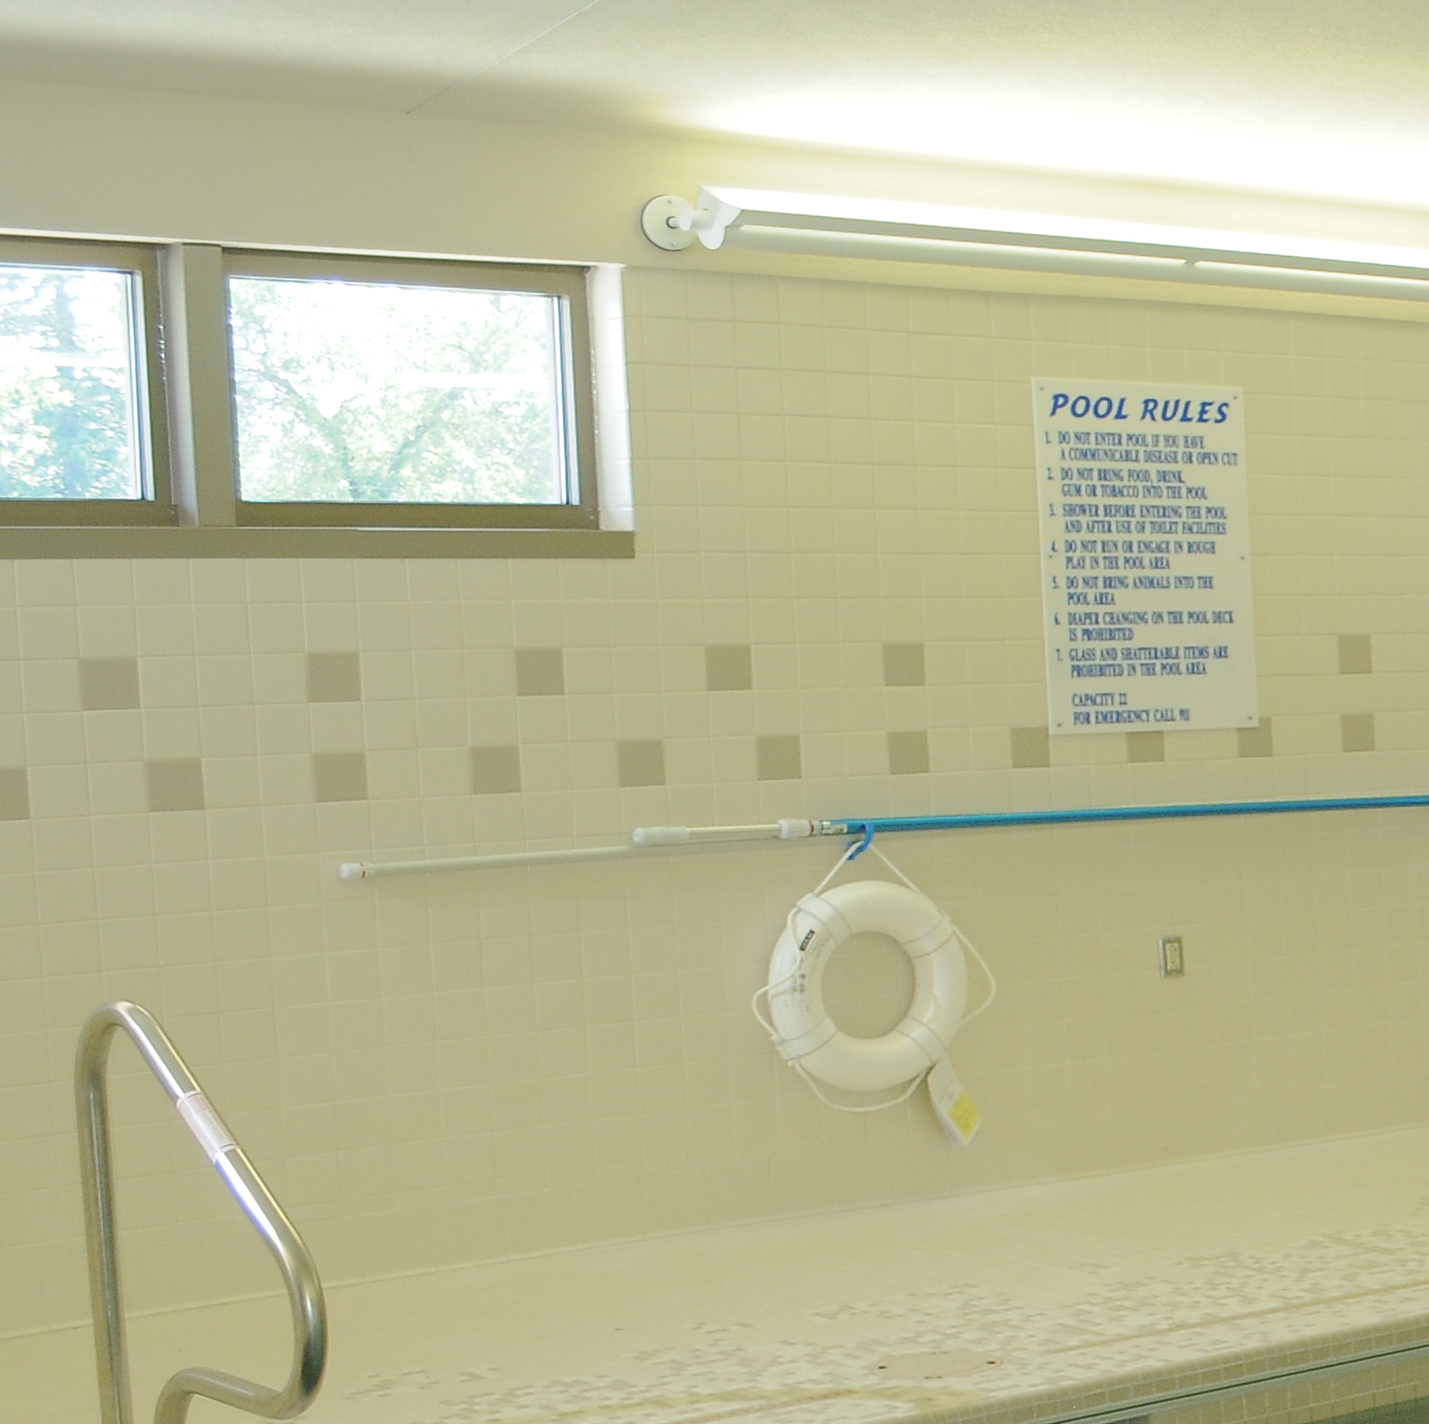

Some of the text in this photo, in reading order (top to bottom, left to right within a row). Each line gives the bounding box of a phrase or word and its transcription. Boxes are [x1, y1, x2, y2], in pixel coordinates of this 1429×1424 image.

[1049, 393, 1230, 424] POOL RULES
[1058, 432, 1072, 444] DO
[1074, 432, 1092, 445] NOT
[1095, 433, 1124, 446] ENTER
[1127, 433, 1149, 447] POOL
[1152, 434, 1161, 447] IF
[1164, 434, 1180, 448] YOU
[1183, 435, 1204, 448] HAVE
[1060, 448, 1238, 465] A COMMUNICABLE DISEASE OR OPEN CUT
[1061, 468, 1075, 481] DO
[1077, 468, 1095, 481] NOT
[1098, 469, 1126, 482] BRING
[1129, 469, 1152, 483] FOOD,
[1061, 484, 1206, 499] GUM OR TOBACCO INTO THE POOL
[1062, 504, 1100, 517] SHOWER
[1103, 505, 1136, 518] BEFORE
[1139, 505, 1183, 518] ENTERING
[1185, 506, 1202, 519] THE
[1205, 506, 1226, 519] POOL
[1064, 520, 1226, 534] AND AFTER USE OF TOILET FACILITIES
[1064, 540, 1077, 553] DO
[1080, 540, 1097, 553] NOT
[1101, 541, 1119, 553] RUN
[1121, 541, 1134, 553] OR
[1137, 541, 1170, 553] ENGAGE
[1173, 541, 1184, 553] IN
[1187, 541, 1216, 554] ROUGH
[1065, 556, 1170, 569] PLAY IN THE POOL AREA
[1066, 577, 1079, 589] DO
[1082, 576, 1099, 589] NOT
[1102, 576, 1129, 589] BRING
[1132, 576, 1171, 589] ANIMALS
[1173, 576, 1195, 589] INTO
[1197, 576, 1213, 588] THE
[1067, 592, 1115, 605] POOL AREA
[1068, 612, 1101, 625] DIAPER
[1104, 612, 1151, 625] CHANGING
[1154, 612, 1167, 624] ON
[1169, 611, 1186, 624] THE
[1189, 611, 1209, 624] POOL
[1213, 611, 1233, 624] DECK
[1069, 628, 1133, 641] IS PROHIBITED
[1069, 648, 1098, 661] GLASS
[1101, 648, 1119, 660] AND
[1122, 647, 1181, 660] SHATTERABLE
[1184, 646, 1211, 659] ITEMS
[1213, 646, 1229, 658] ARE
[1070, 662, 1206, 678] PROHIBITED IN THE POOL AREA
[1071, 693, 1115, 706] CAPACITY
[1073, 712, 1091, 725] FOR
[1094, 710, 1149, 724] EMERGENCY
[1153, 709, 1175, 722] CALL
